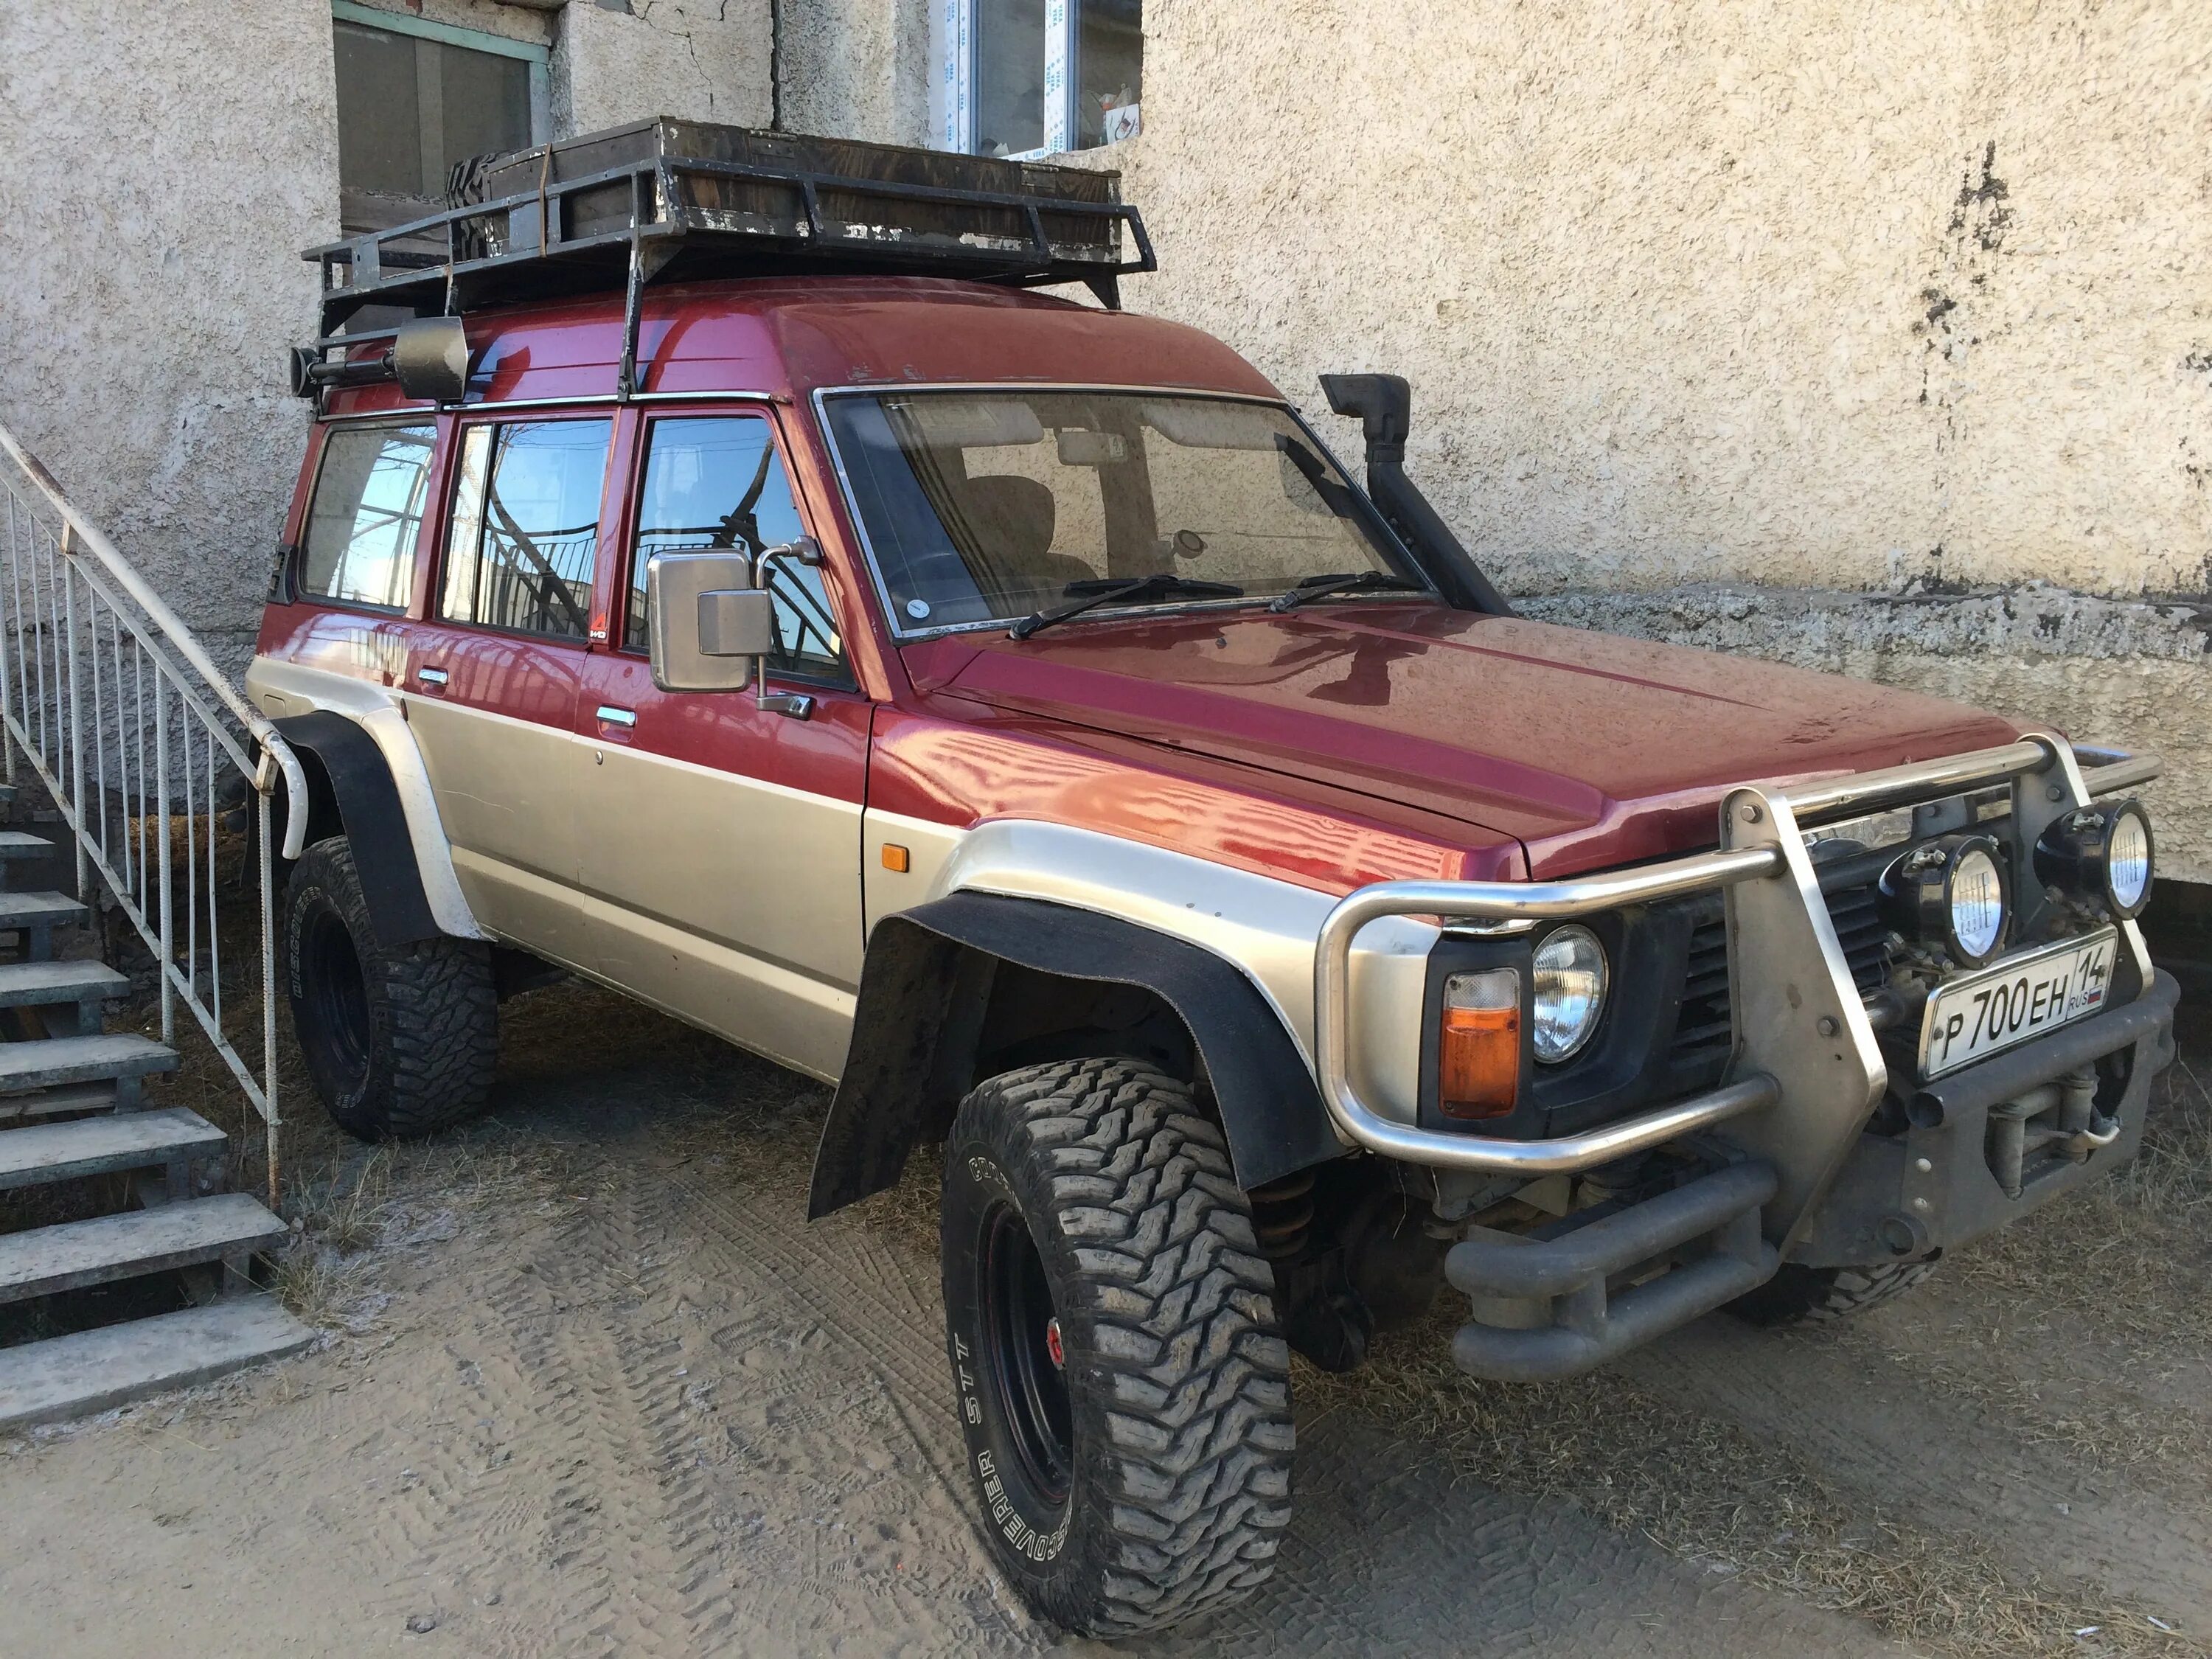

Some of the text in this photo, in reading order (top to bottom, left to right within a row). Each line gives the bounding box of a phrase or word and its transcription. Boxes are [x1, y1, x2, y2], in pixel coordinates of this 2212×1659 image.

[2079, 945, 2104, 991] 14
[2069, 991, 2088, 1010] RUS
[954, 1332, 981, 1425] STT
